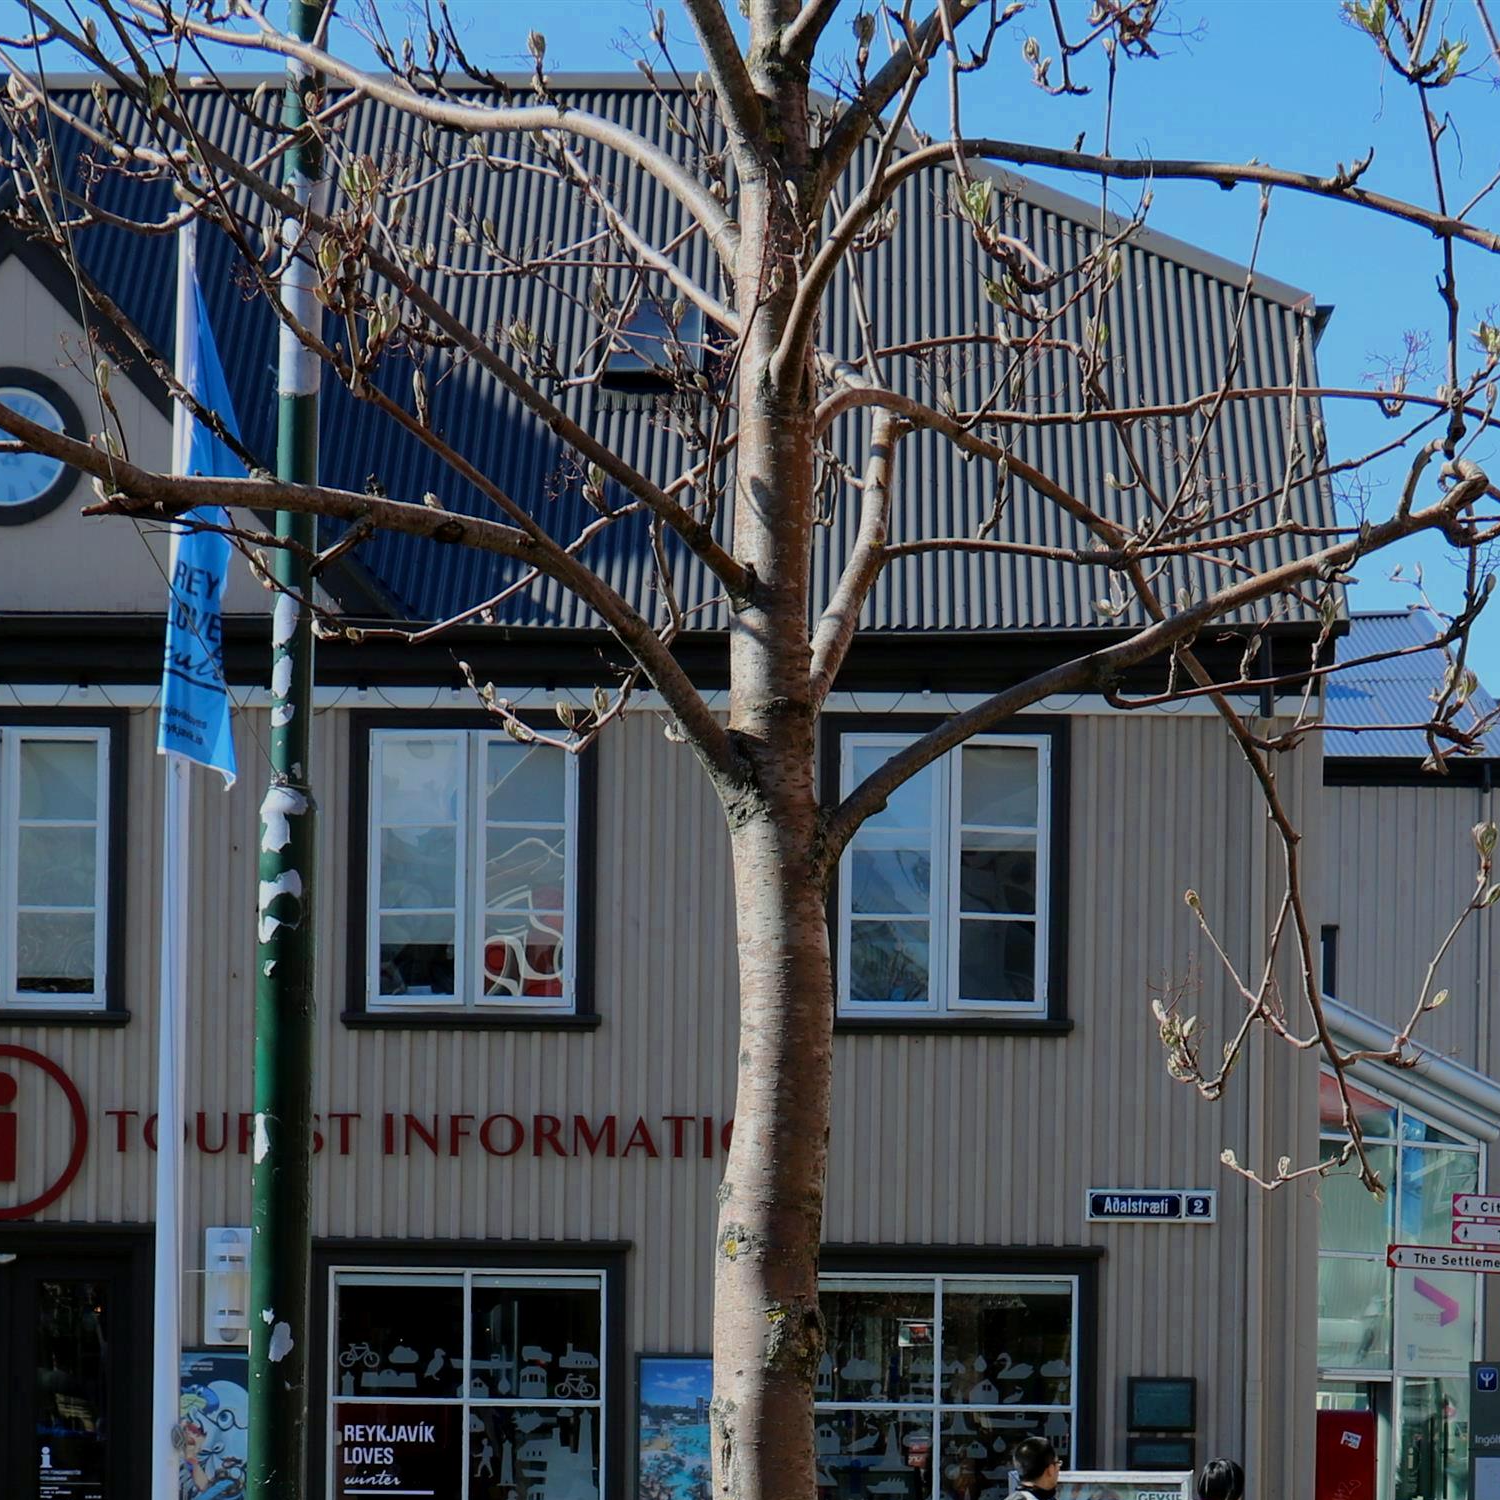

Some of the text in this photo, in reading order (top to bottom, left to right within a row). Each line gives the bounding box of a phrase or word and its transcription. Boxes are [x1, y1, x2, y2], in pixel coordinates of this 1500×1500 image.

[1103, 1196, 1204, 1215] Aðalstræti 2
[1413, 1252, 1437, 1265] The
[343, 1421, 435, 1443] REYKJAVÍK
[343, 1446, 394, 1465] LOVES
[344, 1469, 401, 1486] winter
